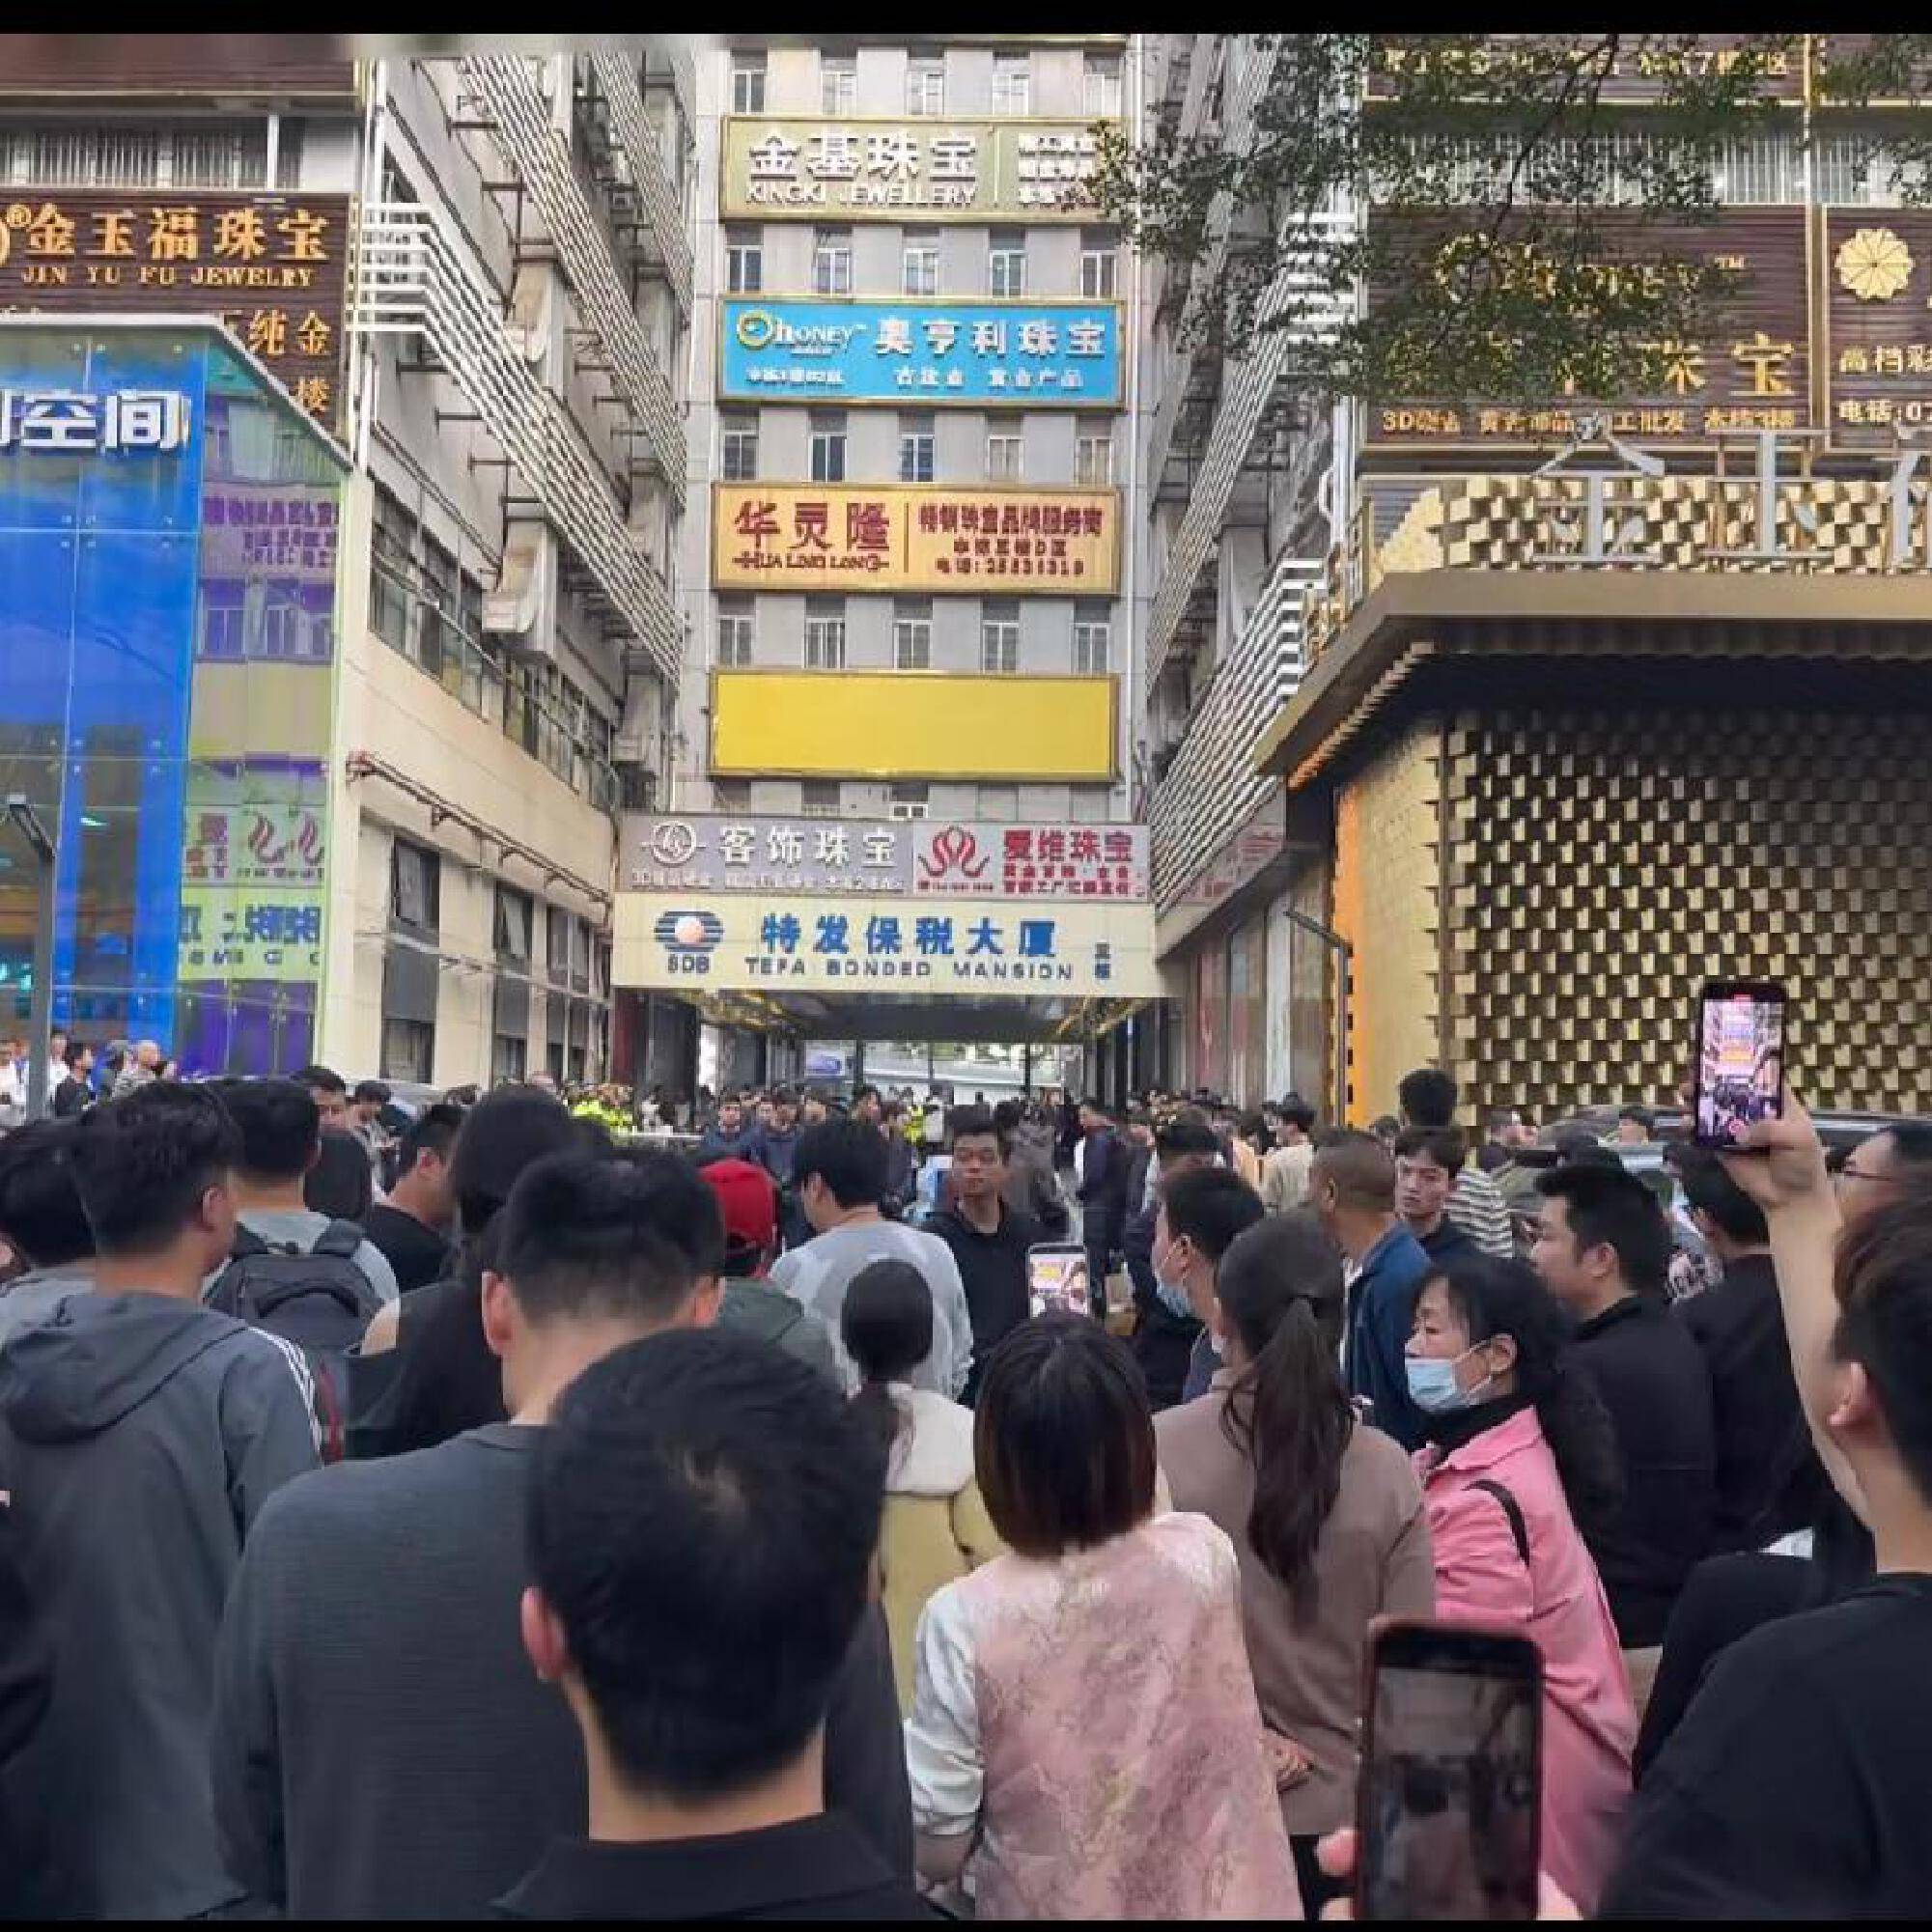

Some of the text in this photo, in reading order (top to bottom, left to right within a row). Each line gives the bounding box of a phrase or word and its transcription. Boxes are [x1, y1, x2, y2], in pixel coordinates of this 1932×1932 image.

[746, 131, 976, 181] 金基珠宝
[838, 183, 976, 206] JEWELLERY
[24, 202, 330, 261] 金玉福珠宝
[21, 266, 315, 287] JIN YU FU JEWELRY
[875, 317, 1106, 358] 奥亨利珠宝
[734, 500, 890, 551] 华灵隆
[718, 825, 898, 868] 客饰珠宝
[760, 912, 1056, 958] 特发保税大厦
[743, 956, 805, 975] TEFA
[826, 958, 931, 977] BONDED
[953, 961, 1074, 980] MANSION
